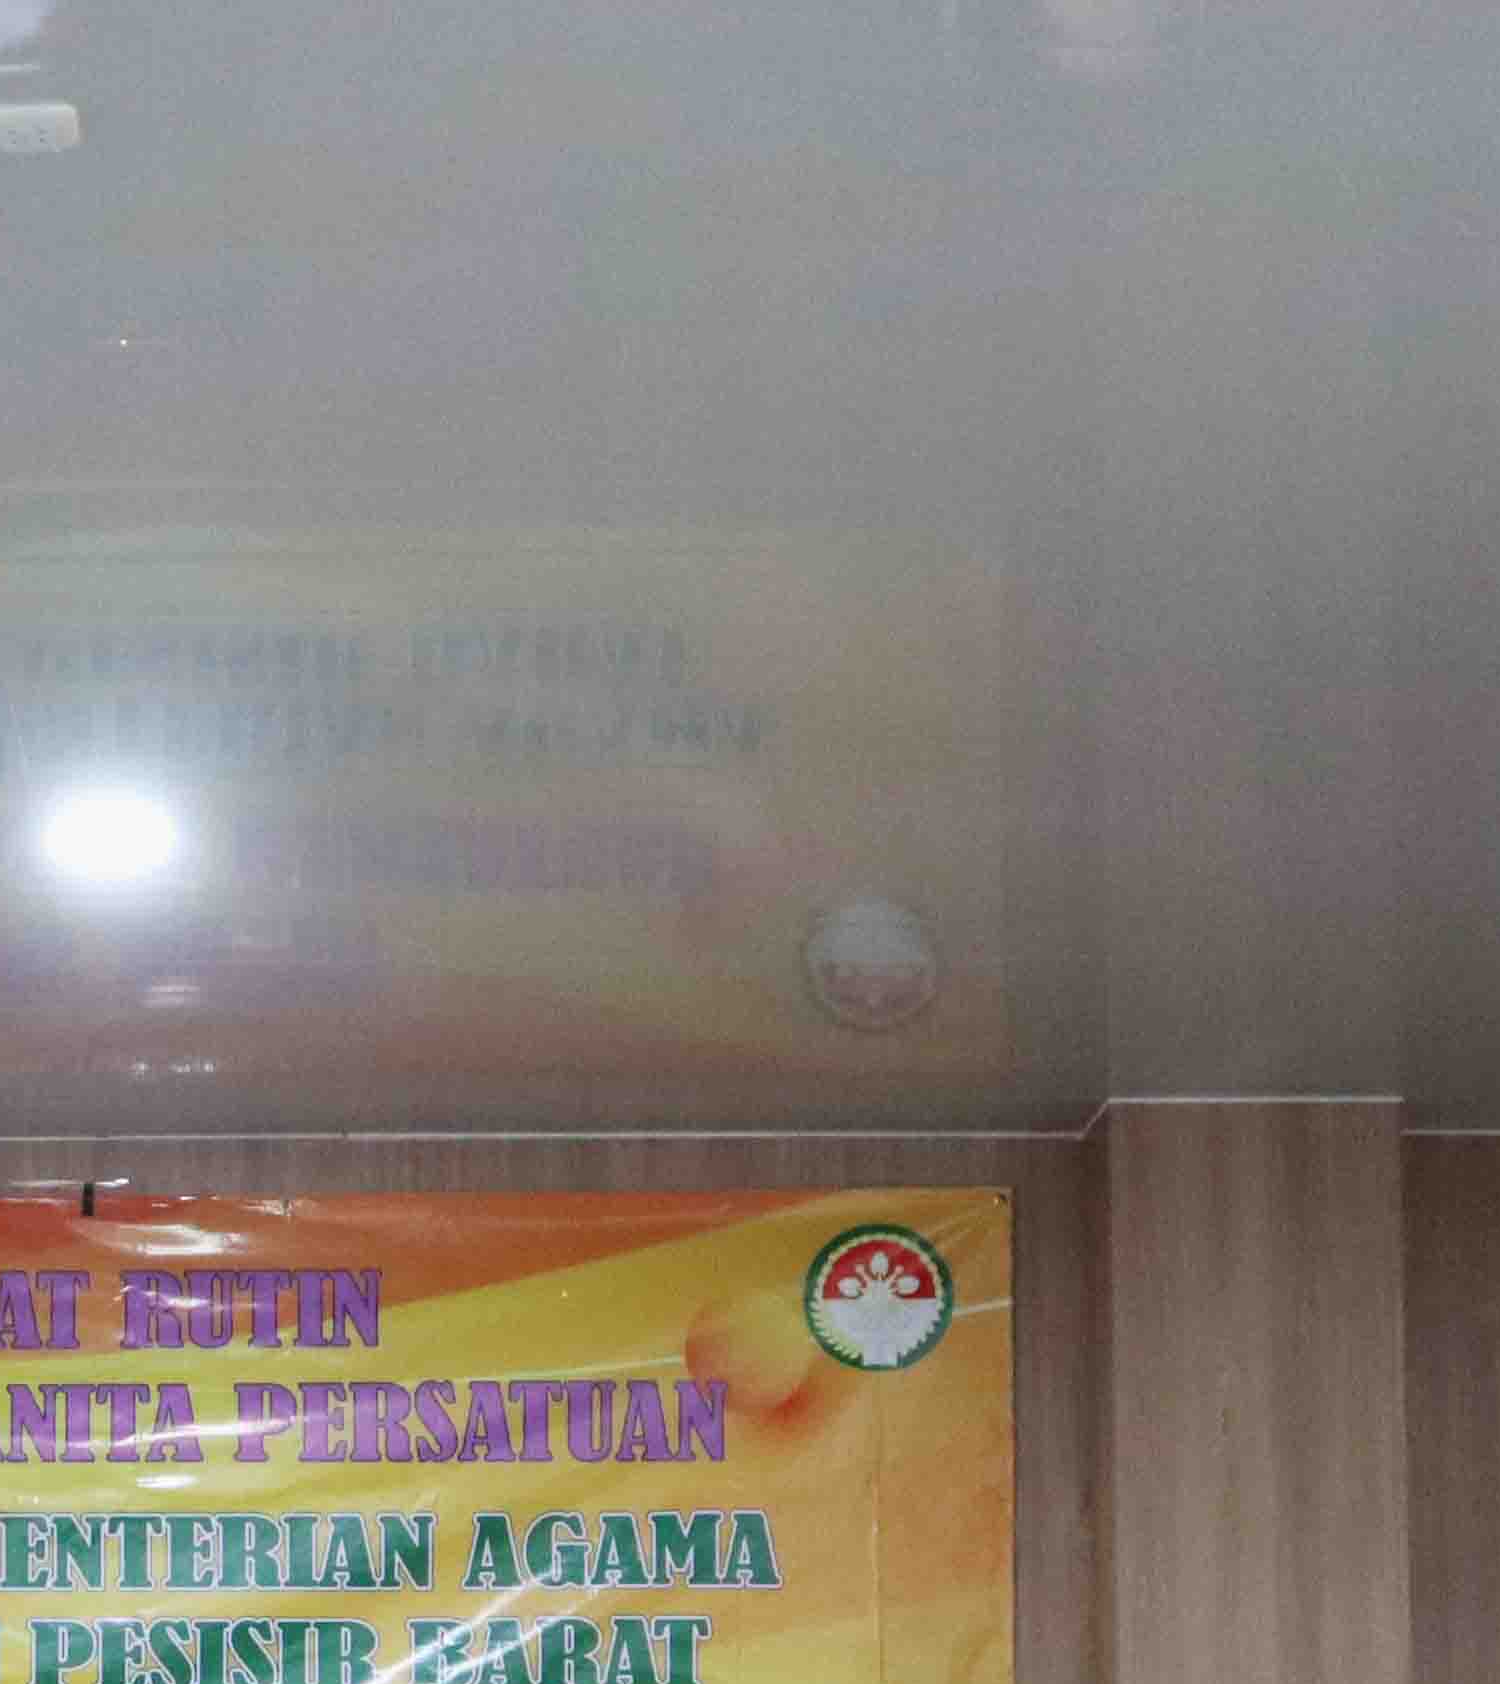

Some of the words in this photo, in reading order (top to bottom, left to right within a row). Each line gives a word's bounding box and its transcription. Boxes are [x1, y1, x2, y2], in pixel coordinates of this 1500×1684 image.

[118, 1269, 382, 1348] RUTIN
[233, 1380, 728, 1462] PERSATUAN
[462, 1510, 783, 1590] AGAMA
